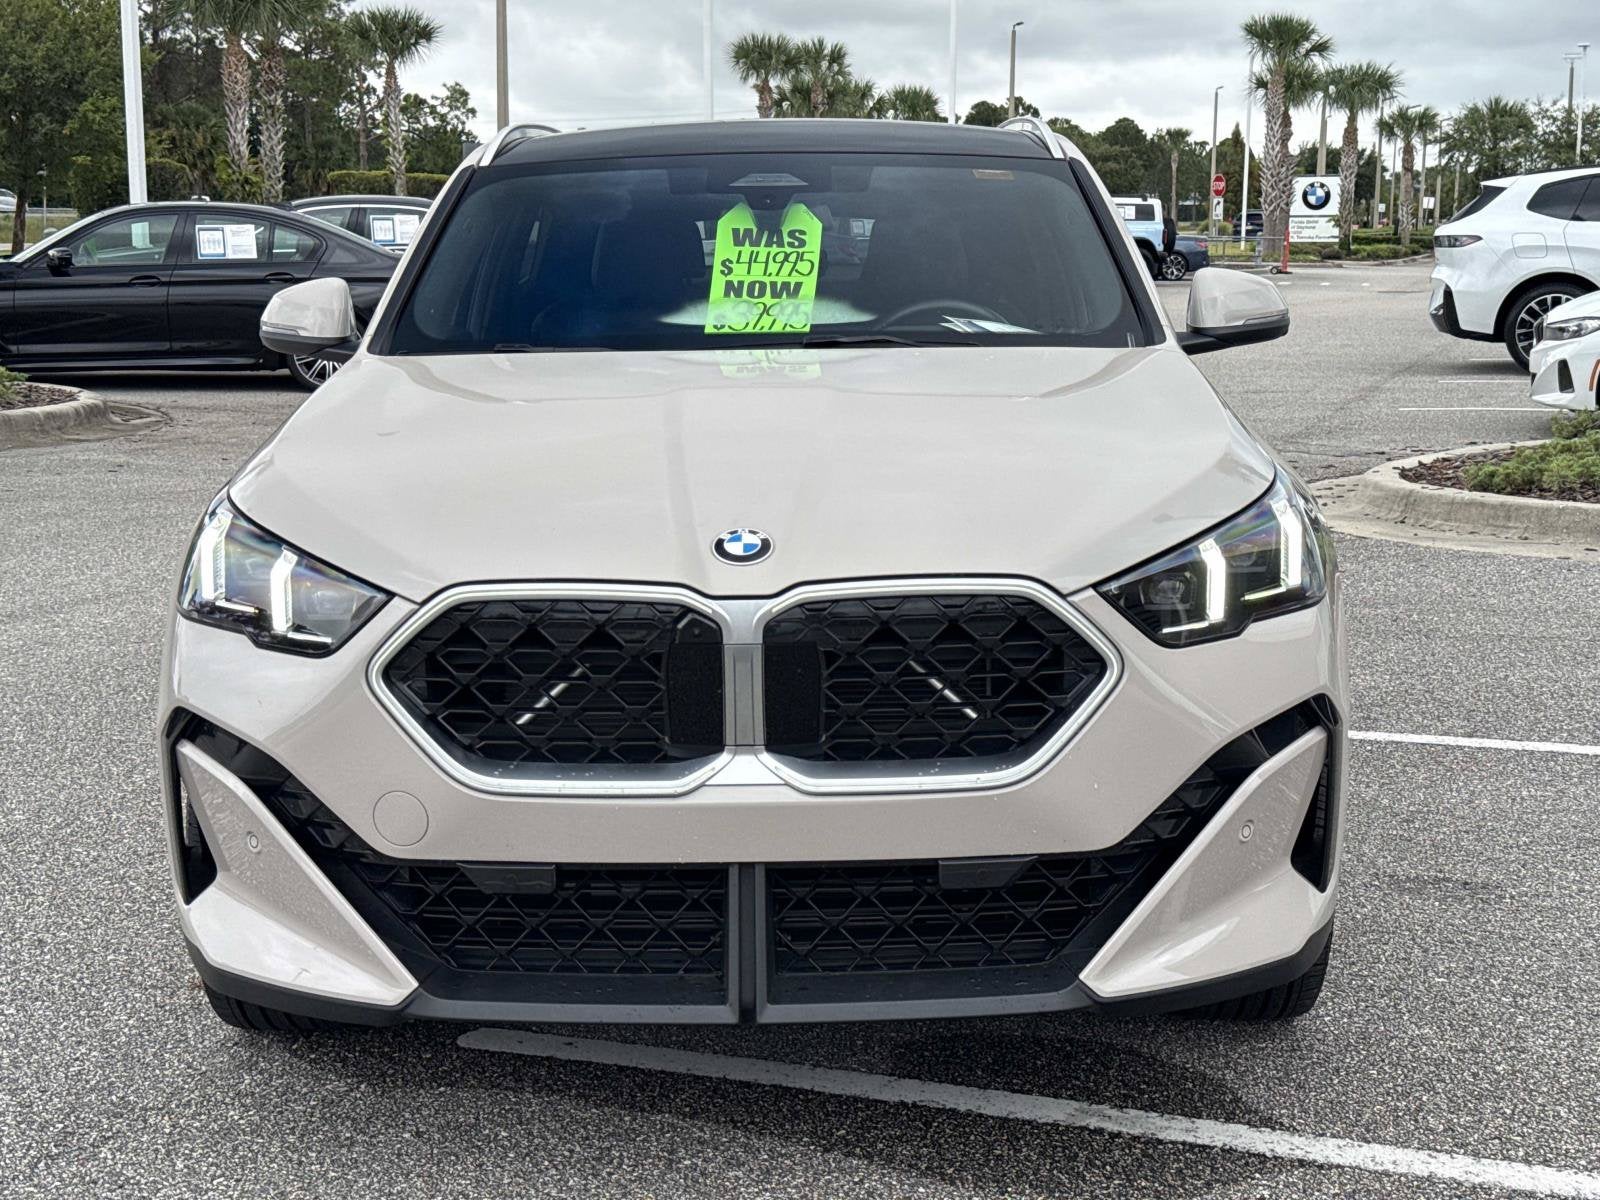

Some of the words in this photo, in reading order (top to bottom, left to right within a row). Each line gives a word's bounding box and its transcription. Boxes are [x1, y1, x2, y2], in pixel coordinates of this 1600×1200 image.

[1213, 181, 1225, 190] STOP
[731, 227, 807, 248] WAS
[723, 280, 803, 299] NOW
